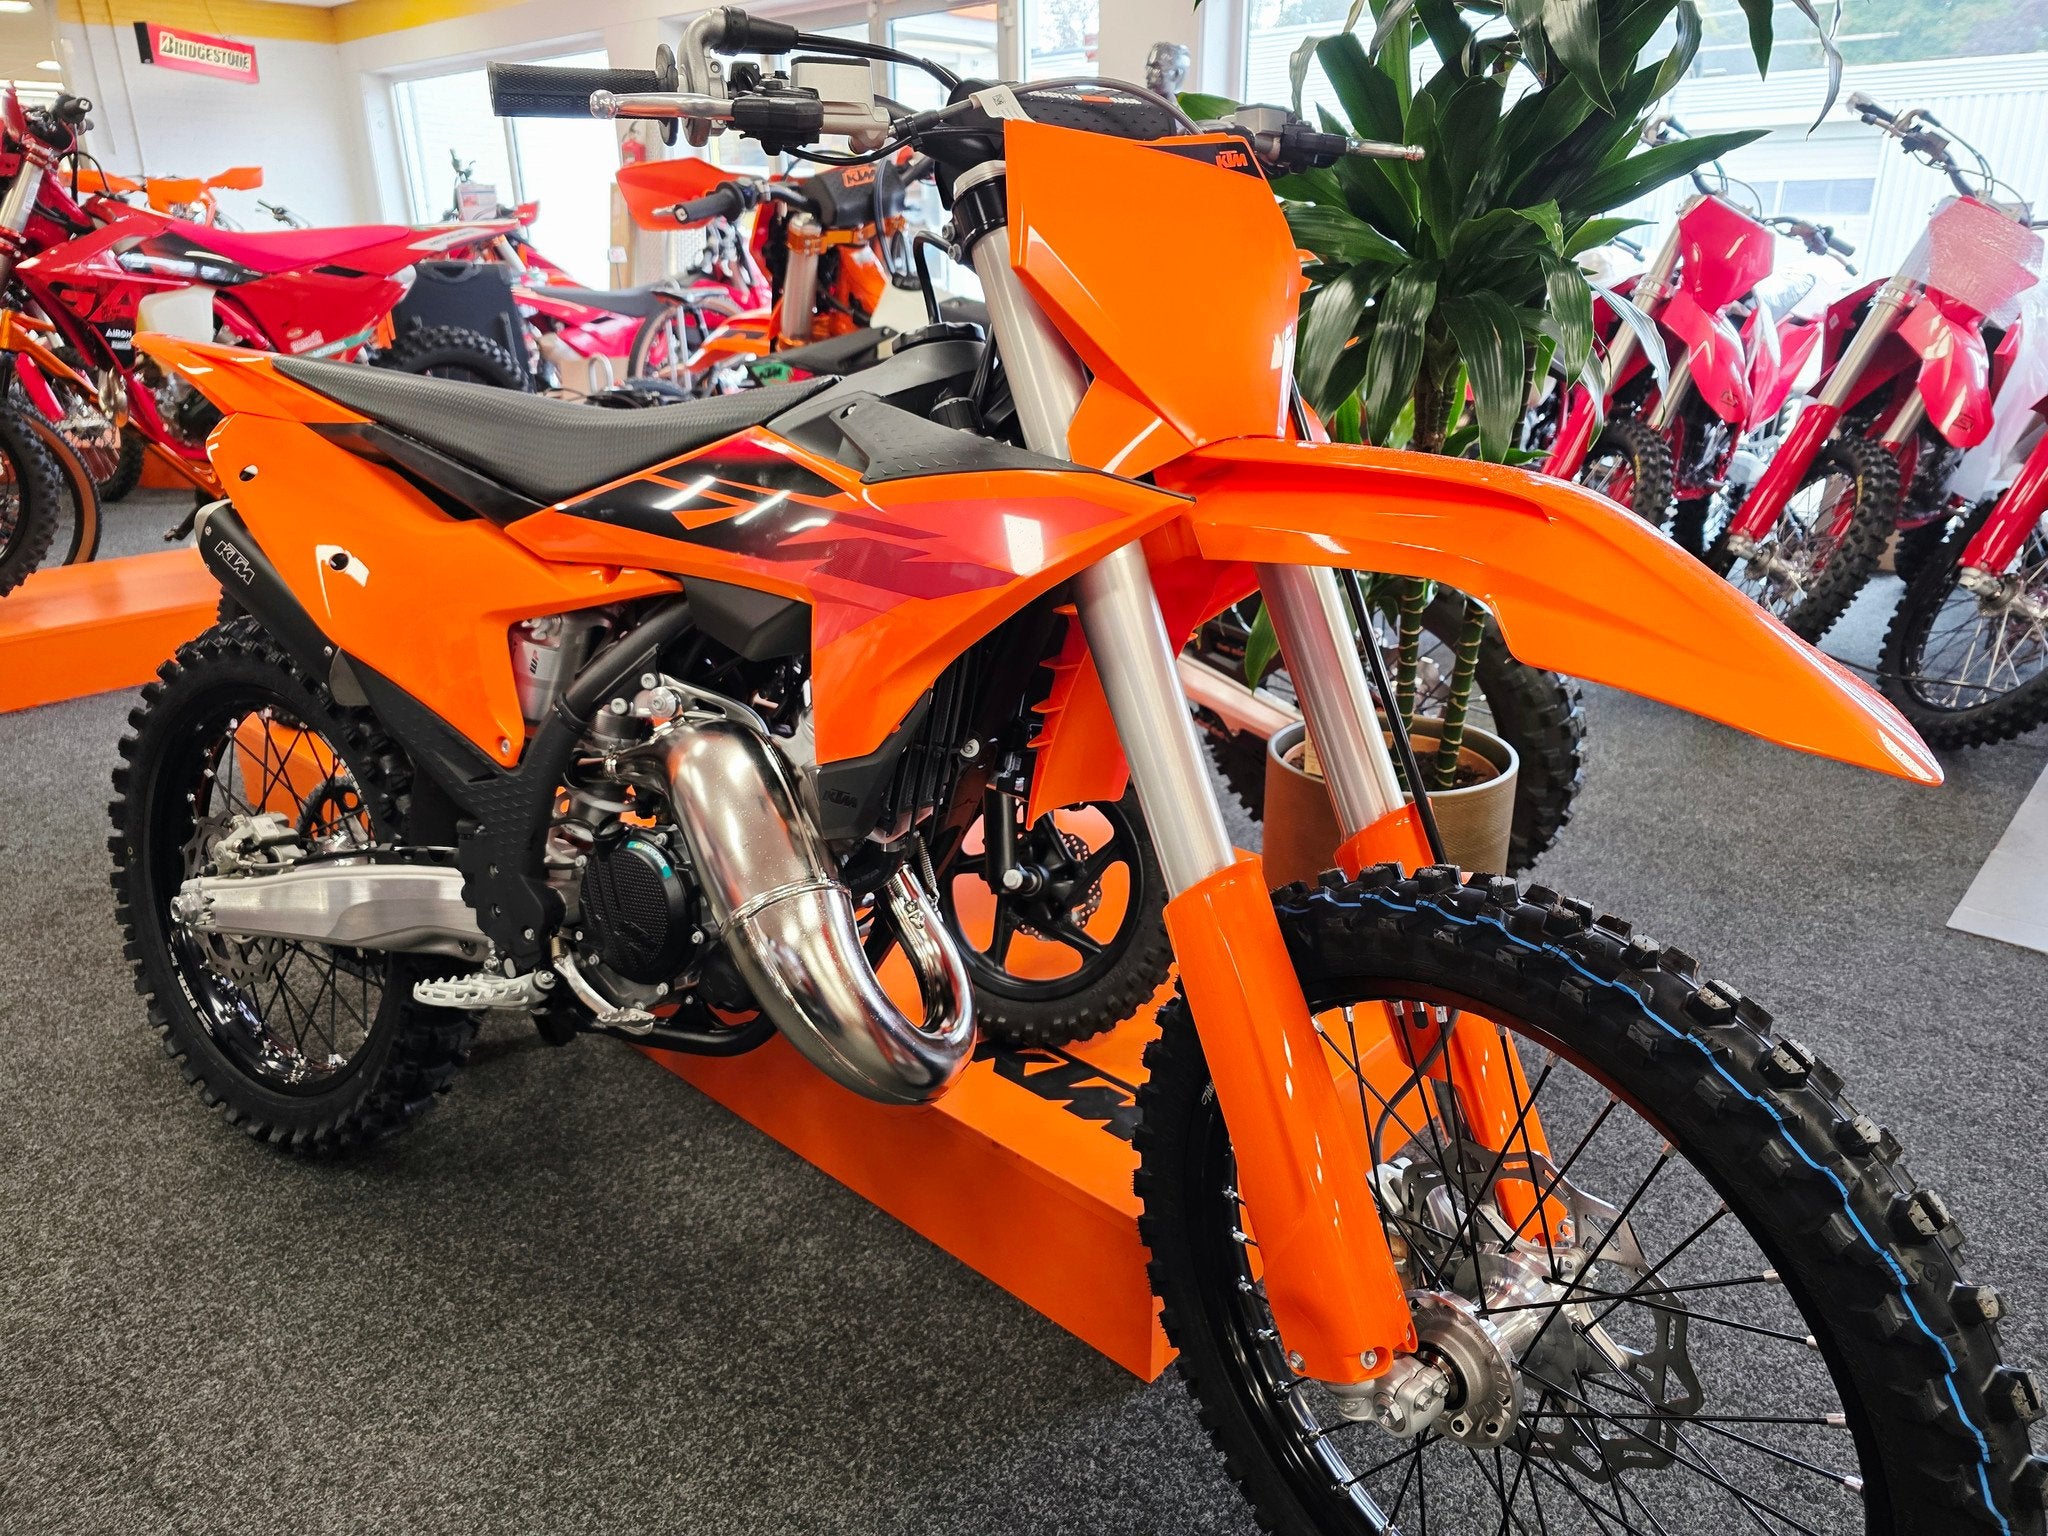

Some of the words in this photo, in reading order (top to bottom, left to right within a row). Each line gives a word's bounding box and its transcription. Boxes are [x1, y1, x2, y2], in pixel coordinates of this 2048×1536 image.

[161, 35, 249, 70] BRIDGESTONE
[1215, 150, 1248, 168] KTM
[105, 328, 132, 338] AIROH
[214, 540, 256, 585] KTM
